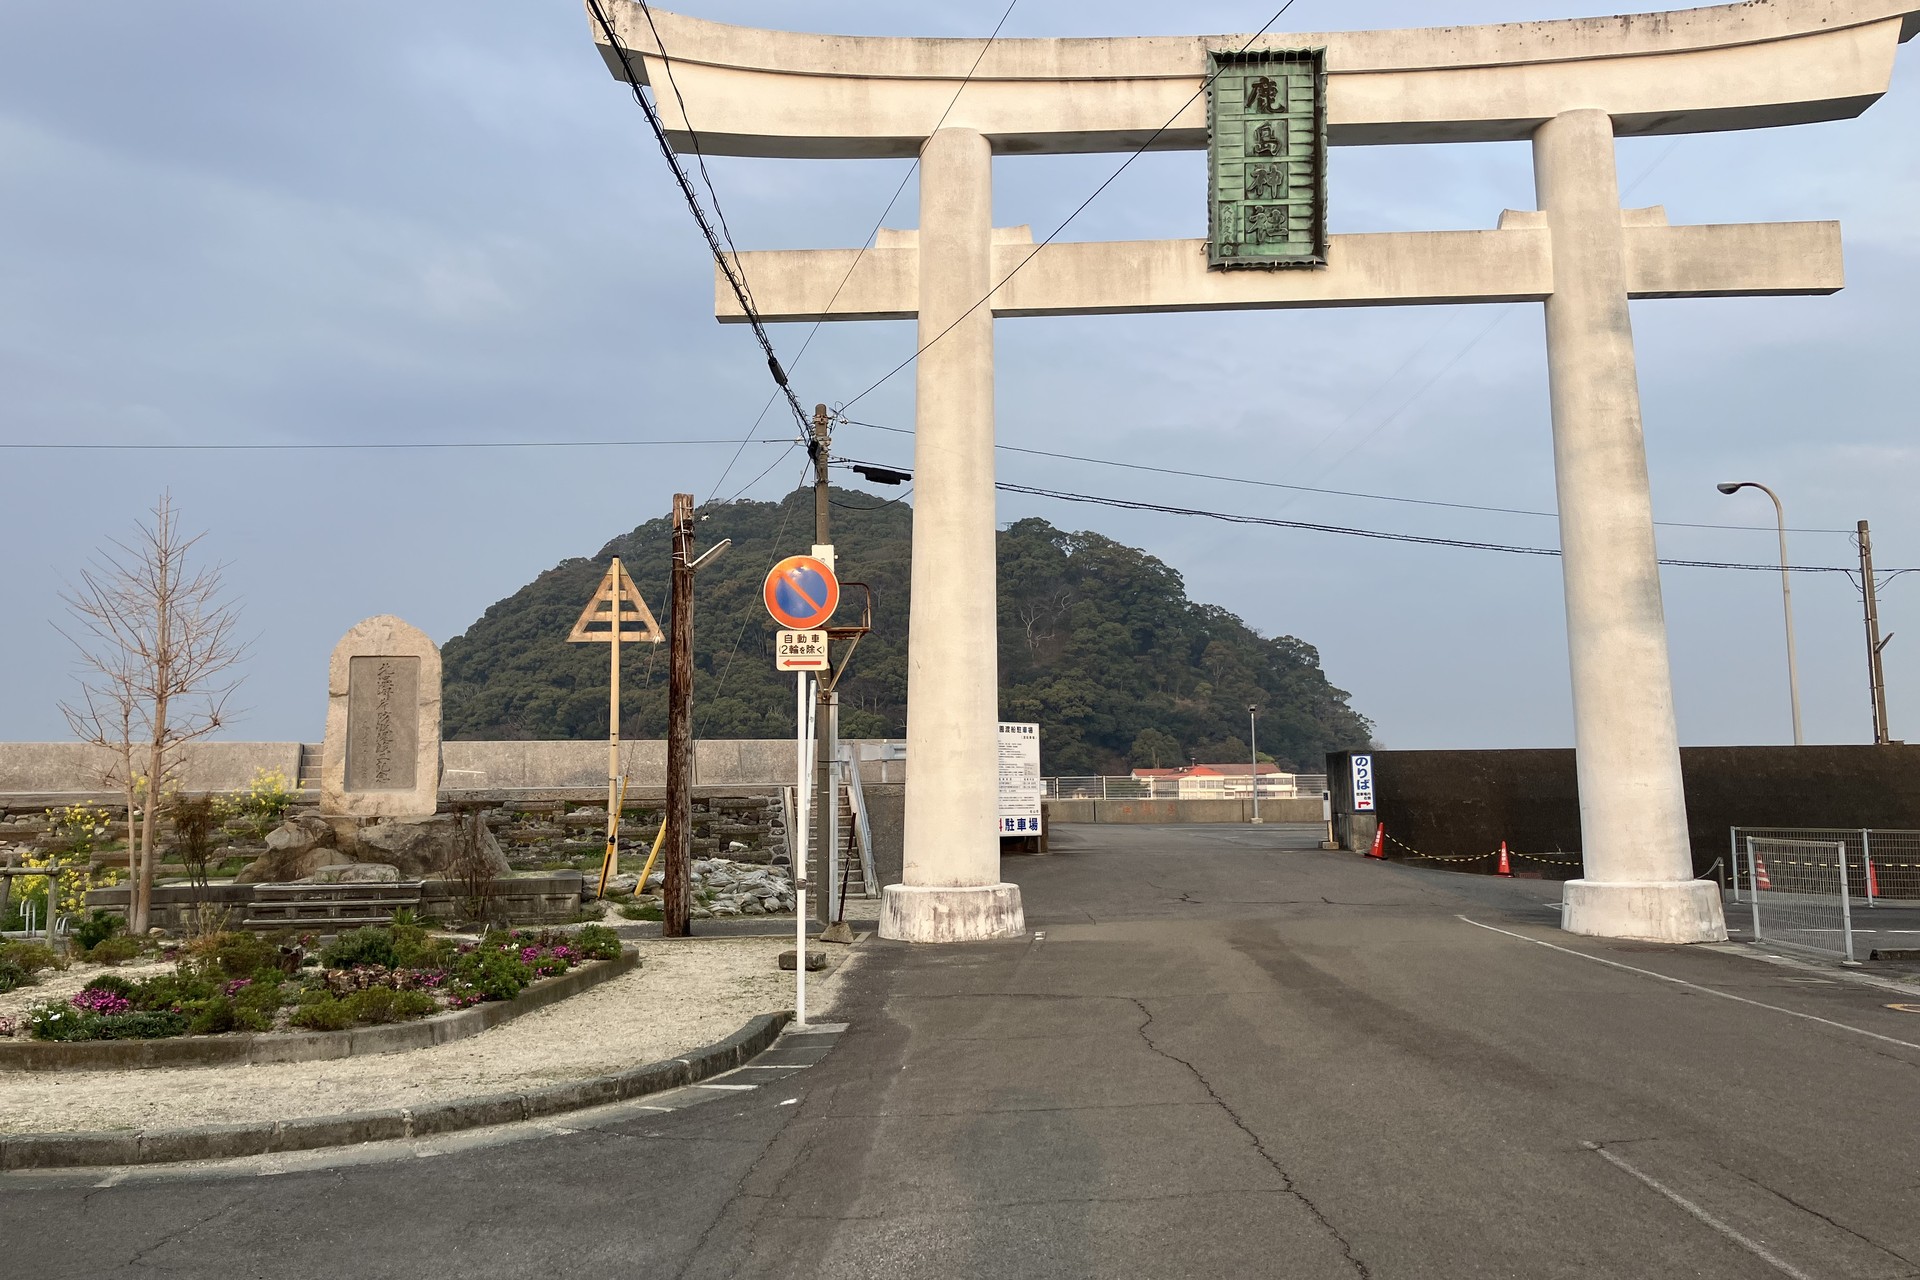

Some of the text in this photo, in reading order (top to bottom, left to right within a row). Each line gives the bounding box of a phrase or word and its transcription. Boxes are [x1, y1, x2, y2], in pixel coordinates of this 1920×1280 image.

[1246, 76, 1288, 244] 鹿島神社
[784, 634, 820, 643] 自動車
[779, 645, 825, 655] (2輪を除く)
[1355, 757, 1370, 790] のりば
